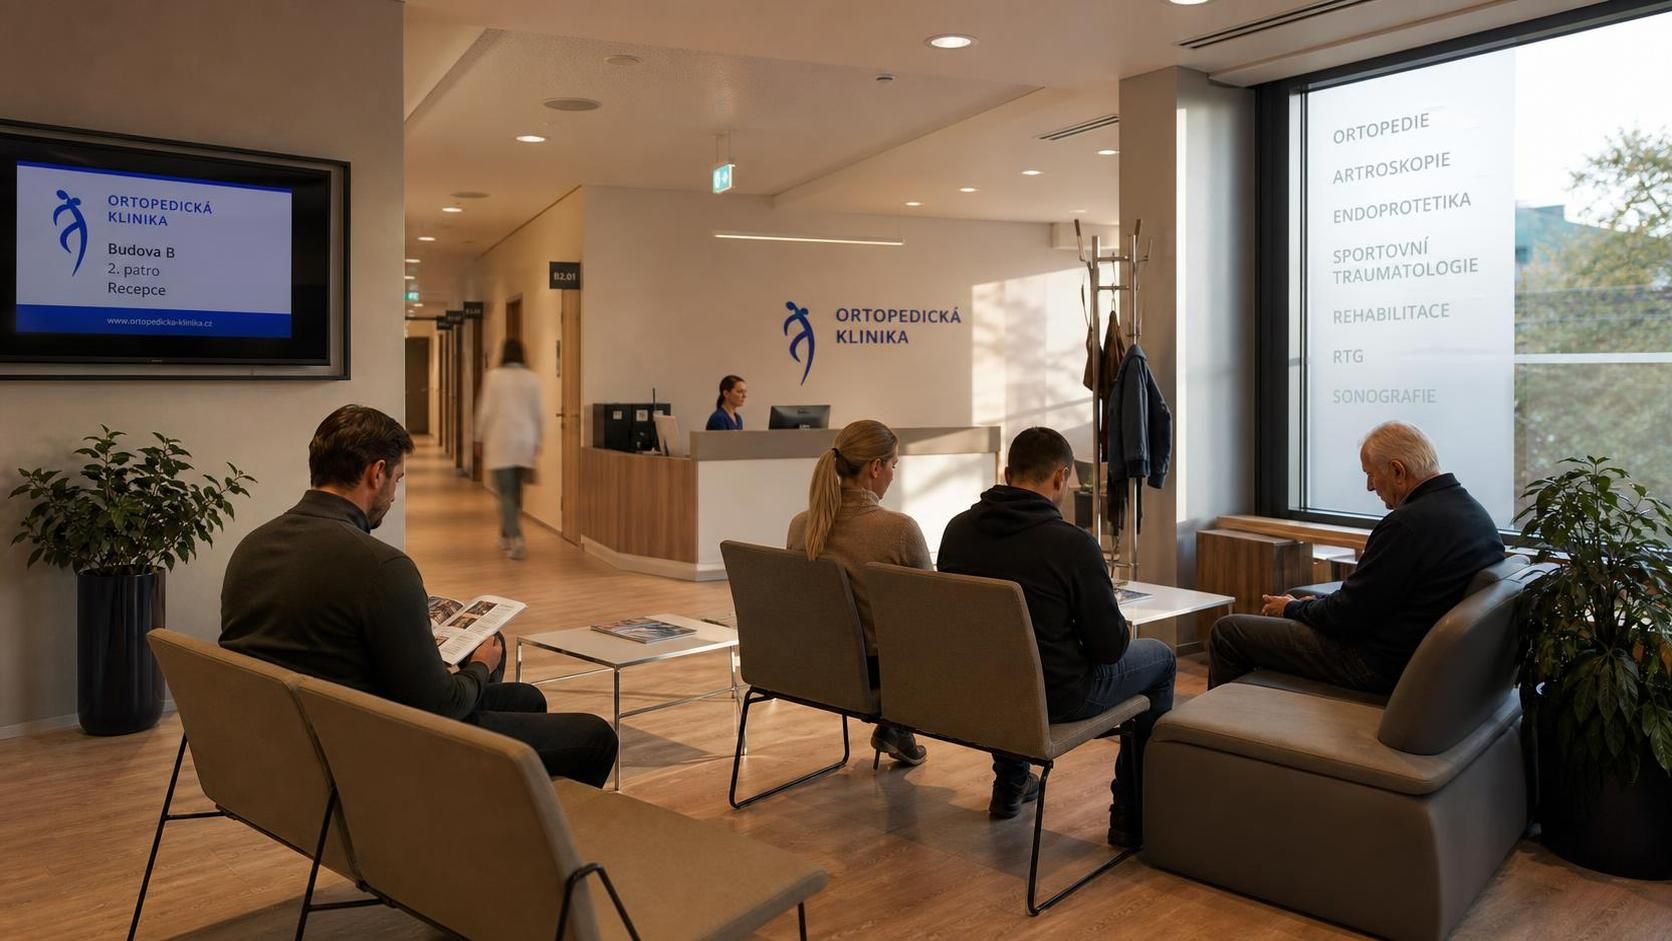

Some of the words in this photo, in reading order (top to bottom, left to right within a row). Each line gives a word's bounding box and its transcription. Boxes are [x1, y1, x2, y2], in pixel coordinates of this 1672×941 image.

[1333, 113, 1430, 144] ORTOPEDIE
[1333, 152, 1451, 184] ARTROSKOPIE
[108, 195, 213, 214] ORTOPEDICKÁ
[1333, 192, 1472, 224] ENDOPROTETIKA
[108, 211, 168, 226] KLINIKA
[108, 243, 161, 258] Budova
[166, 247, 175, 258] B
[1333, 236, 1430, 264] SPORTOVNÍ
[108, 263, 120, 275] 2.
[124, 265, 160, 279] patro
[1333, 257, 1479, 284] TRAUMATOLOGIE
[108, 282, 166, 297] Recepce
[836, 307, 961, 323] ORTOPEDICKÁ
[1333, 303, 1450, 324] REHABILITACE
[107, 318, 212, 327] www.ortopedicka-klinika.cz
[836, 330, 909, 344] KLINIKA
[1333, 349, 1364, 363] RTG
[1333, 388, 1437, 404] SONOGRAFIE
